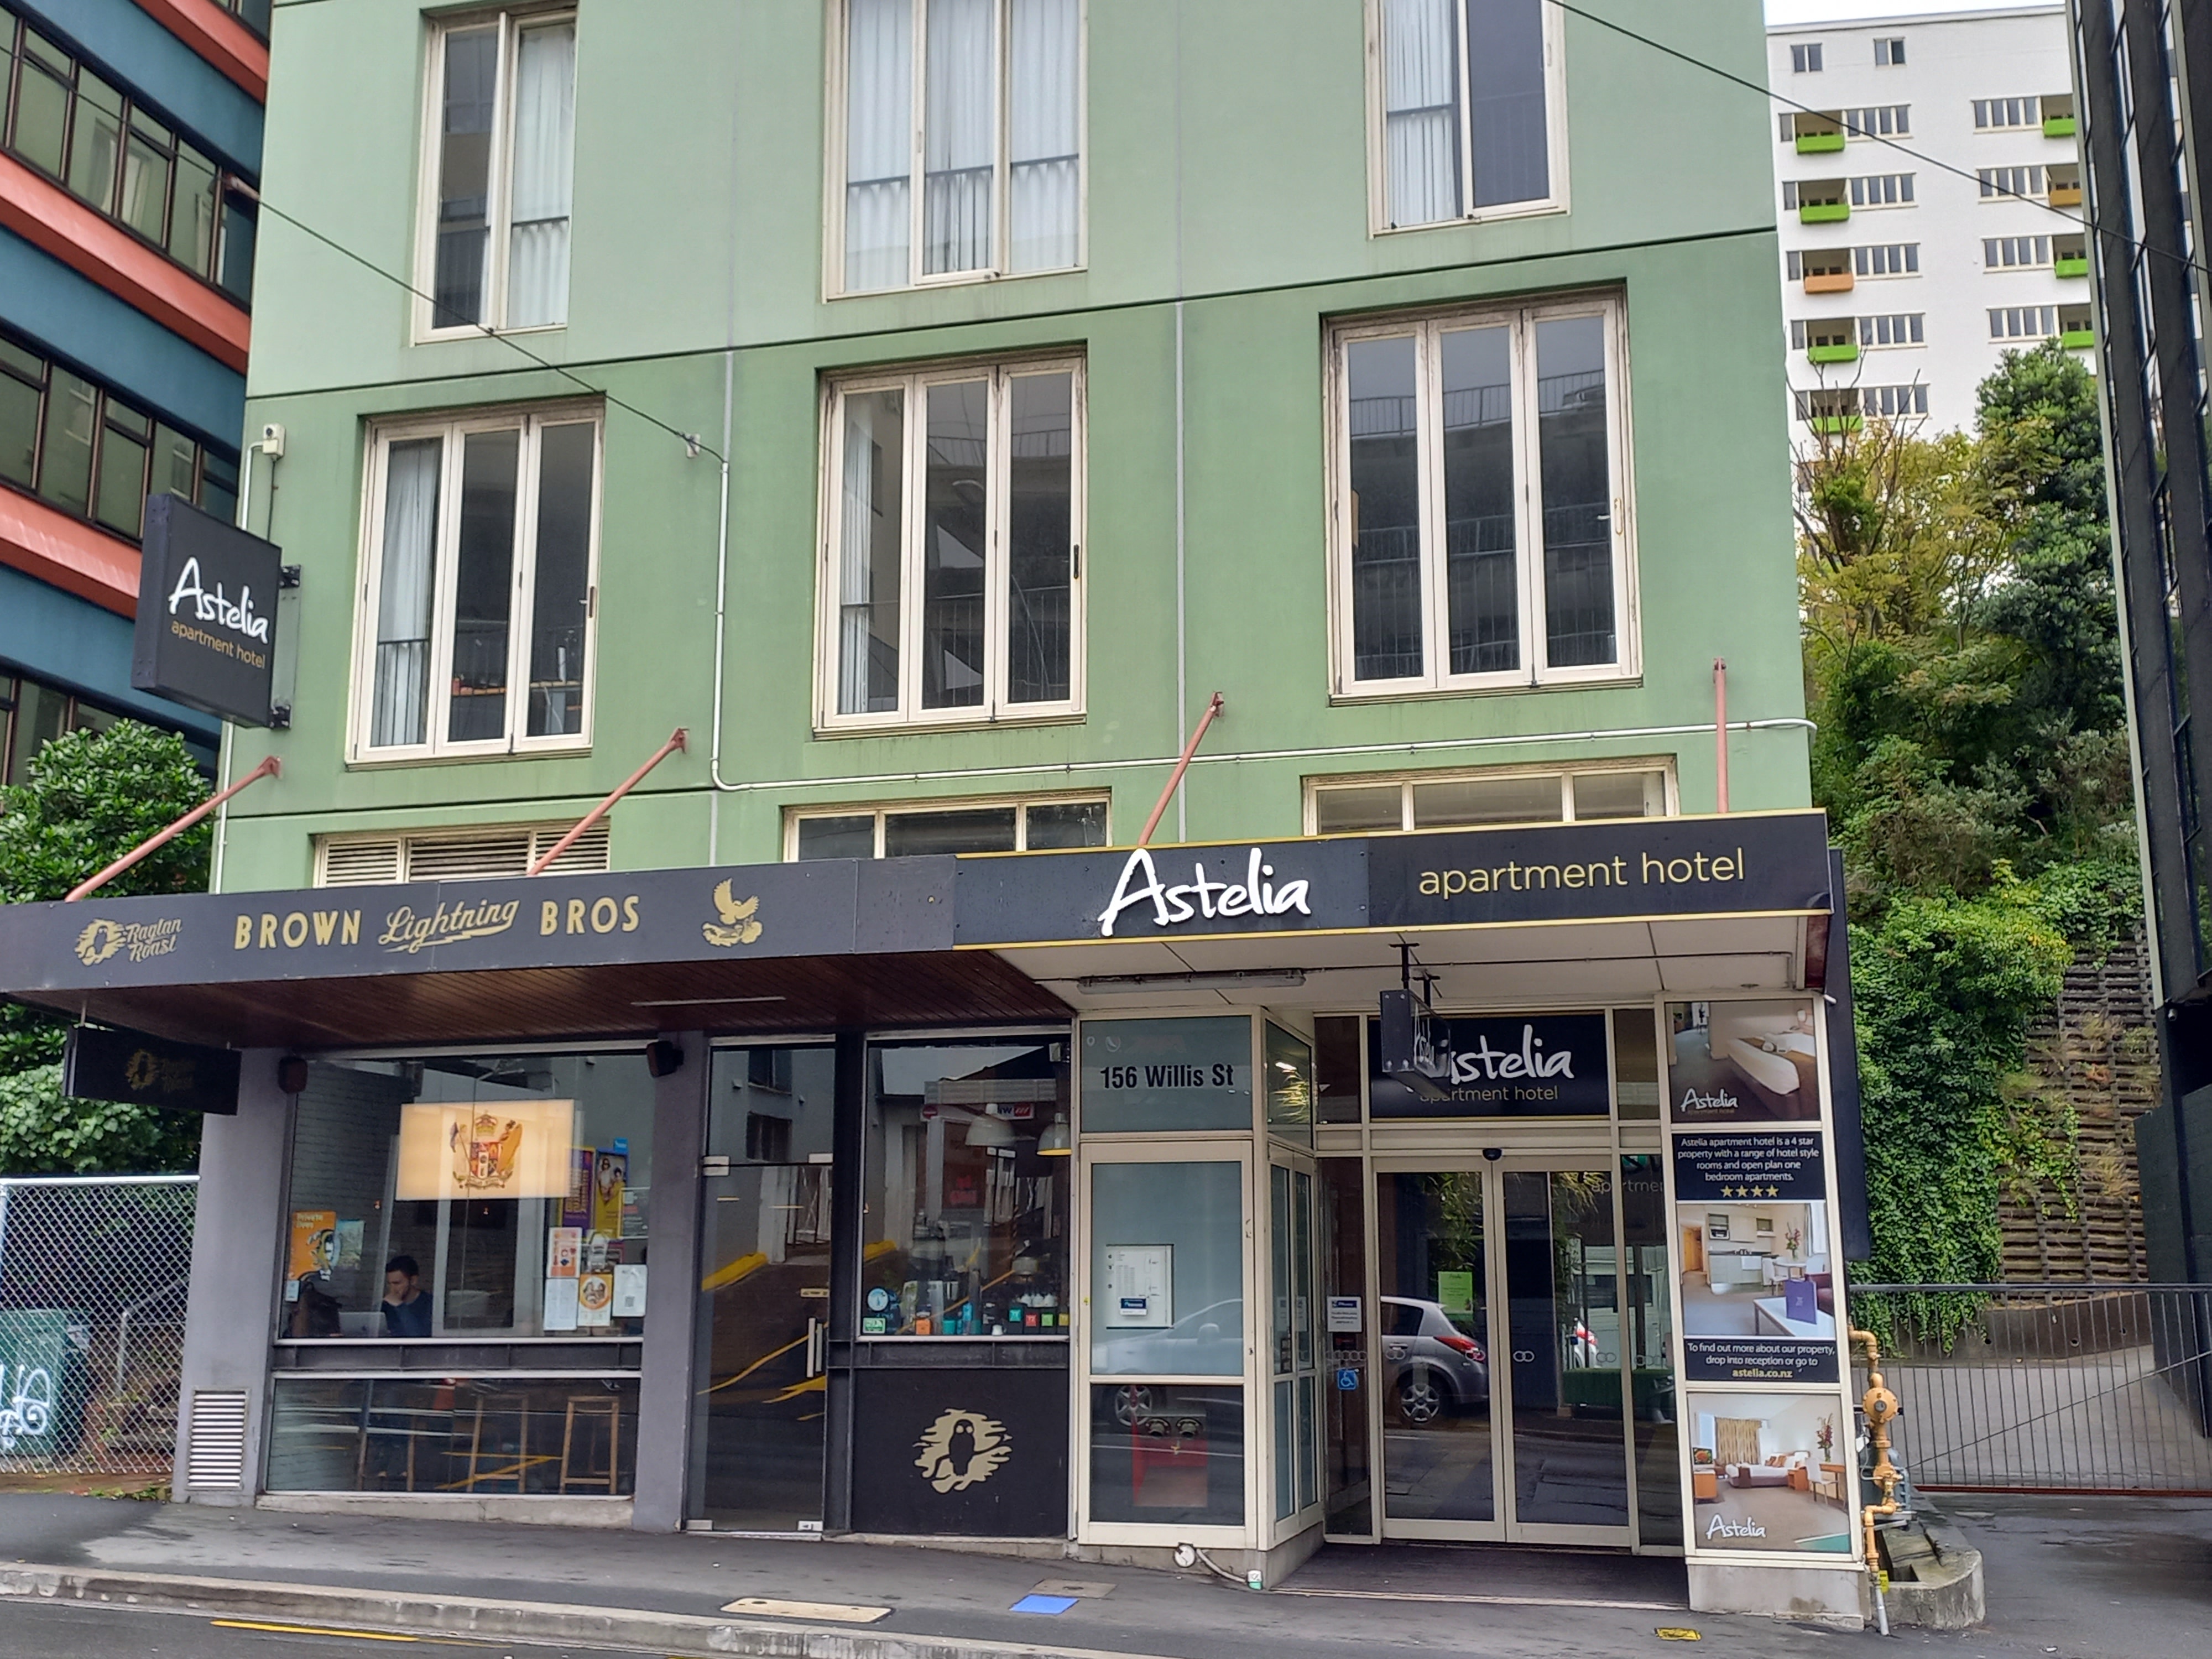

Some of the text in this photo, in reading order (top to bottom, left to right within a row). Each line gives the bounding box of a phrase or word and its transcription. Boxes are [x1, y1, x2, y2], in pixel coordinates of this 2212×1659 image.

[168, 557, 269, 644] Astelia
[171, 620, 265, 670] apartment hotel
[1419, 847, 1744, 900] apartment hotel
[1097, 847, 1311, 937] Astelia
[127, 917, 182, 943] Raglan
[234, 896, 640, 953] BROWN Lightning BROS
[129, 937, 177, 963] Roast
[1451, 1024, 1574, 1084] stelia
[1100, 1063, 1233, 1088] 156 Willis St
[1515, 1085, 1558, 1100] hotel
[1681, 1088, 1738, 1112] Astelia
[1678, 1150, 1713, 1160] property
[1714, 1149, 1733, 1157] with
[1741, 1151, 1764, 1160] range
[1766, 1149, 1775, 1157] of
[1776, 1149, 1797, 1157] hotel
[1799, 1148, 1819, 1158] style
[1681, 1138, 1708, 1146] Astelia
[1709, 1138, 1752, 1149] apartment
[1754, 1137, 1775, 1146] hotel
[1777, 1137, 1783, 1145] is
[1791, 1137, 1797, 1145] 4
[1705, 1172, 1794, 1182] bedroom apartments.
[1724, 1161, 1740, 1169] and
[1741, 1162, 1763, 1171] open
[1765, 1160, 1783, 1171] plan
[1687, 1343, 1697, 1352] To
[1699, 1343, 1715, 1352] find
[1717, 1344, 1731, 1352] out
[1755, 1343, 1780, 1353] about
[1797, 1345, 1835, 1355] property,
[1706, 1355, 1726, 1366] drop
[1727, 1355, 1743, 1364] into
[1745, 1356, 1784, 1366] reception
[1796, 1359, 1807, 1368] go
[1808, 1357, 1818, 1366] to
[1732, 1368, 1793, 1378] astelia.co.nz
[1705, 1514, 1766, 1540] Astelia
